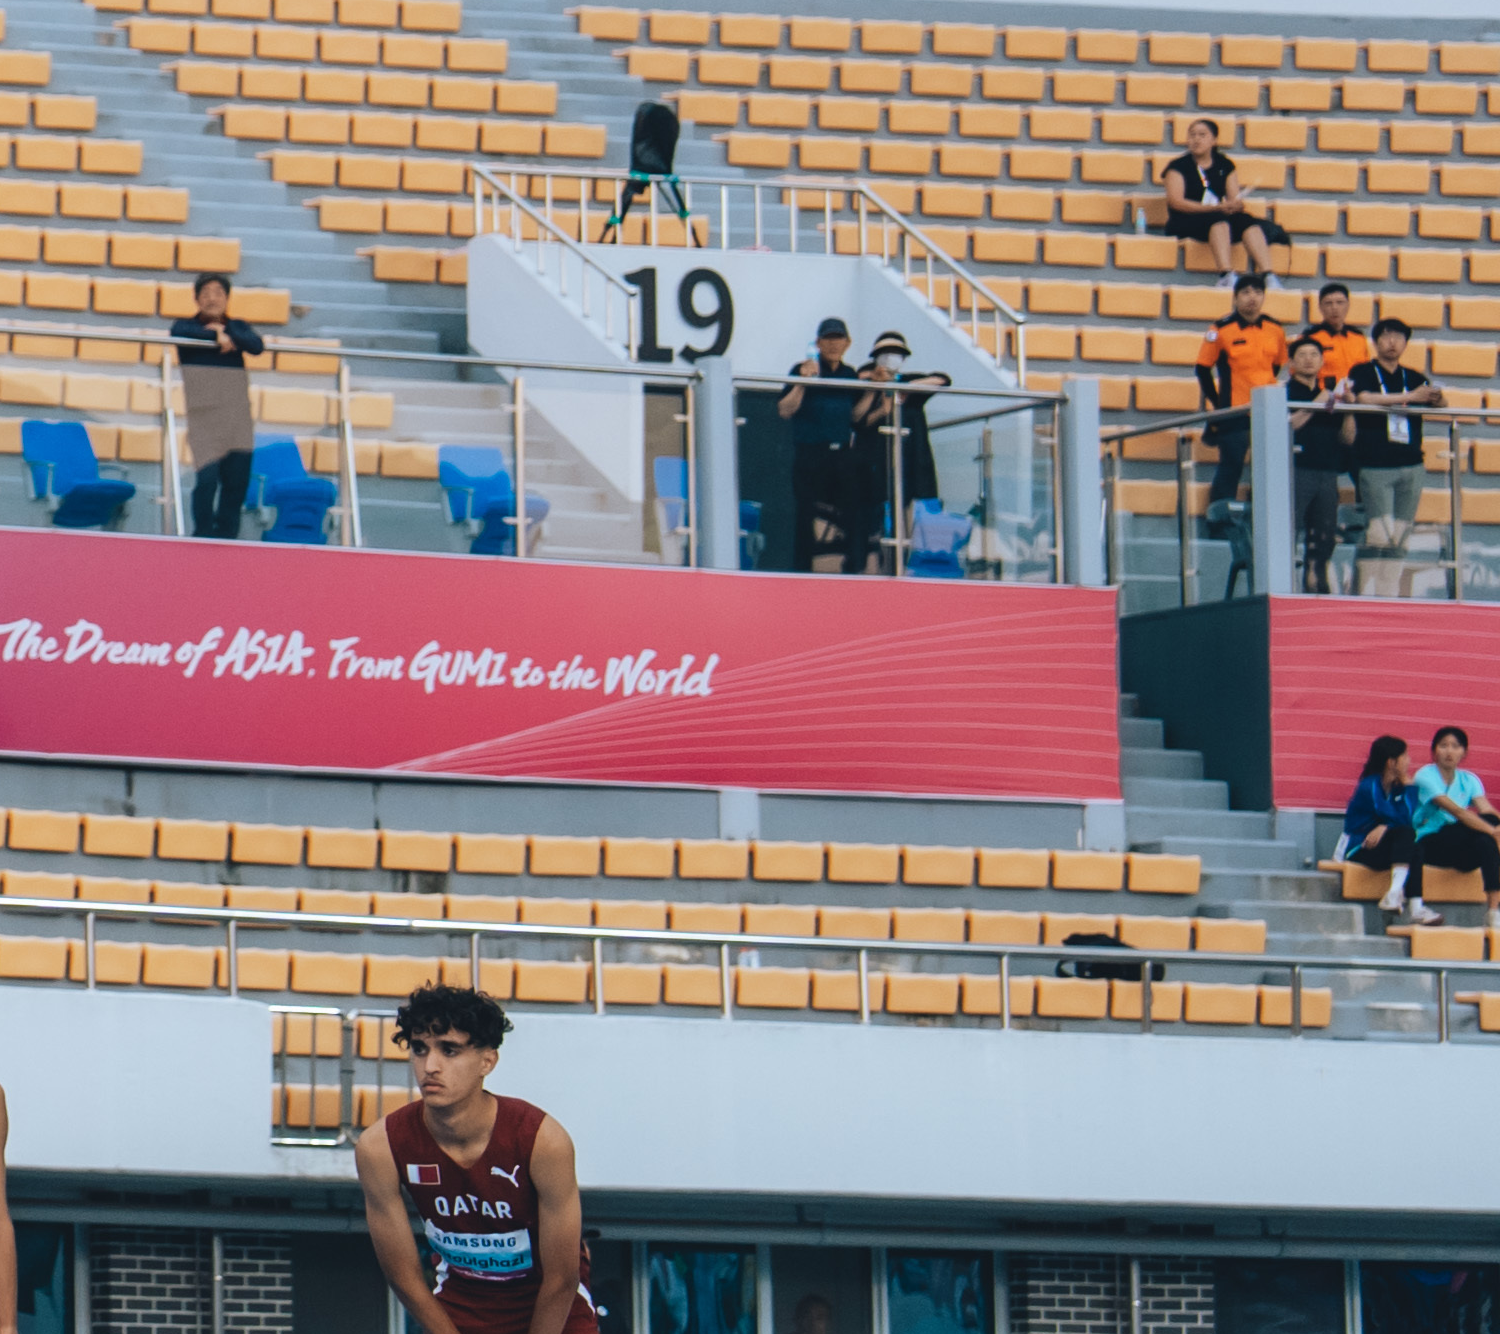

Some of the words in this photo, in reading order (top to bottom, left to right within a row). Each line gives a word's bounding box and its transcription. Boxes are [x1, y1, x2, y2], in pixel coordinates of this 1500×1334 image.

[625, 266, 736, 365] 19
[63, 619, 171, 667] Dream
[175, 626, 223, 677] of
[326, 636, 403, 681] From
[409, 641, 506, 693] GUMI
[510, 652, 546, 688] to
[548, 653, 600, 694] the
[600, 648, 719, 698] World
[434, 1193, 513, 1219] QATAR
[434, 1232, 517, 1248] SAMSUNG
